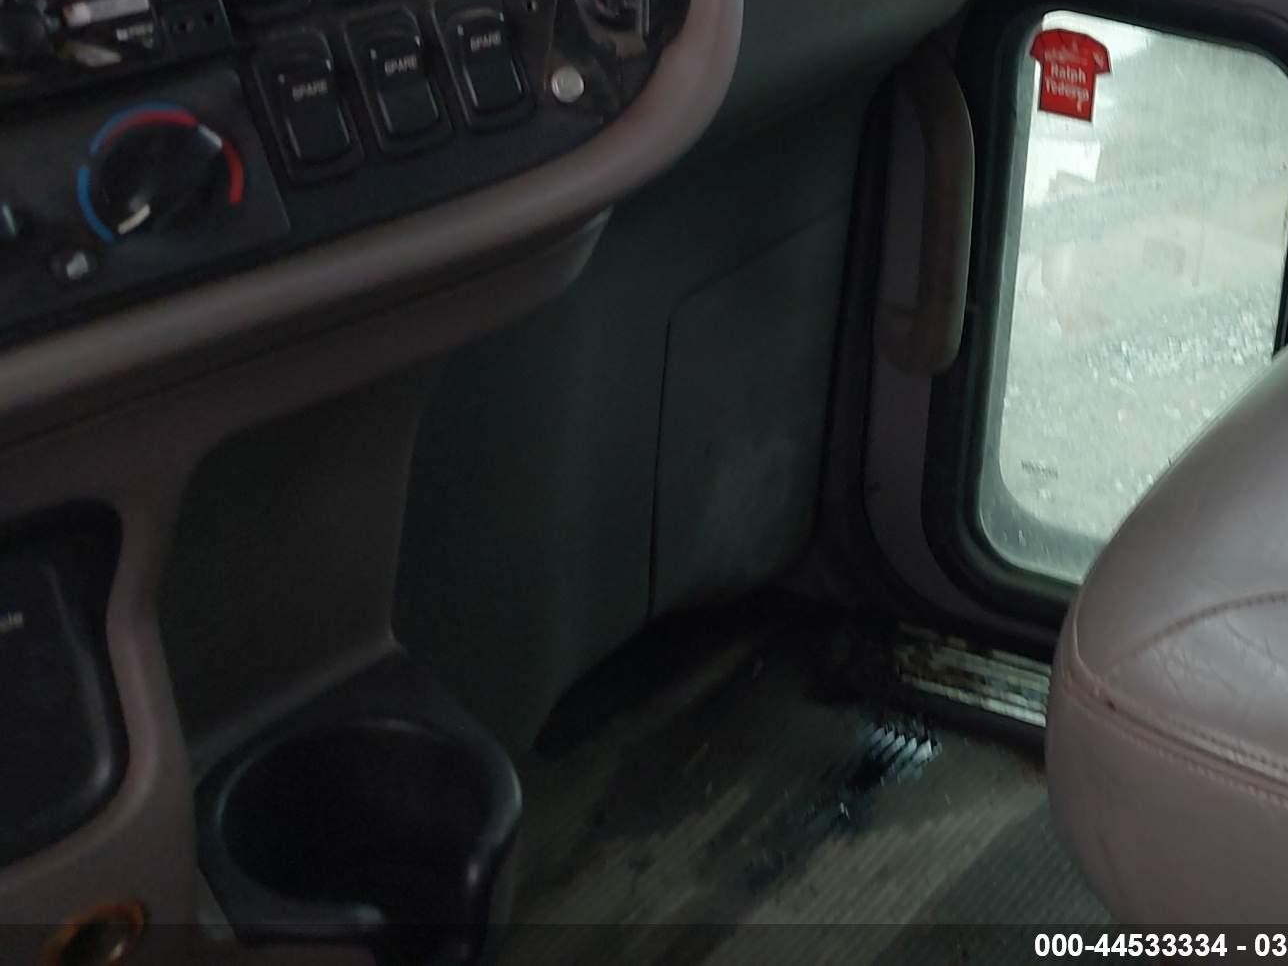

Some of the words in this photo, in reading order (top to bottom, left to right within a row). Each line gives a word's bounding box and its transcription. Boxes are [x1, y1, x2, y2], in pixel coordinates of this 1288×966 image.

[470, 32, 501, 51] SPARE
[385, 56, 418, 75] SPARE
[292, 81, 327, 101] SPARE
